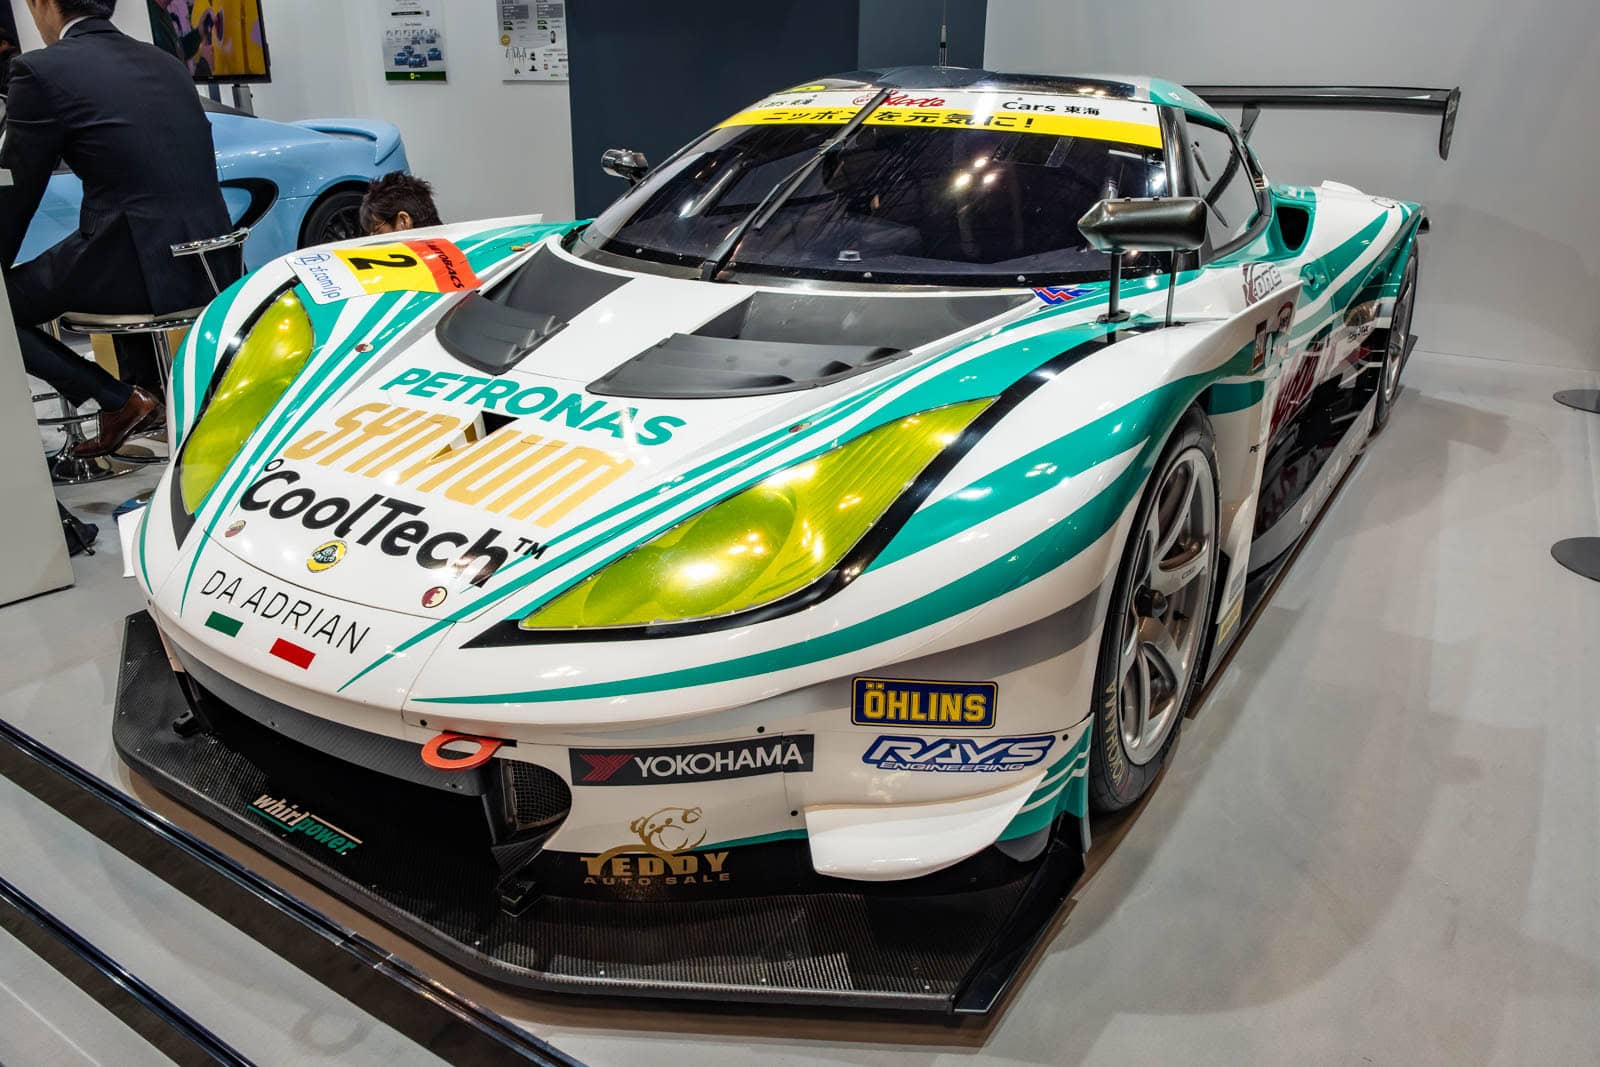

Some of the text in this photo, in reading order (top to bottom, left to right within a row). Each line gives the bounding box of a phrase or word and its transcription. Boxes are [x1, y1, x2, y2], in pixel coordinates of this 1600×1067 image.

[1002, 101, 1101, 116] Cars 東海
[347, 254, 418, 270] 2
[378, 367, 687, 446] PETRONAS
[200, 570, 371, 655] DA ADRIAN
[863, 682, 987, 722] ÖHLINS
[634, 743, 804, 778] YOKOHAMA
[864, 735, 1056, 765] RAYS
[879, 761, 1025, 772] ENGINEERING
[580, 851, 730, 877] TEDDY
[583, 873, 731, 886] AUTO SALE
